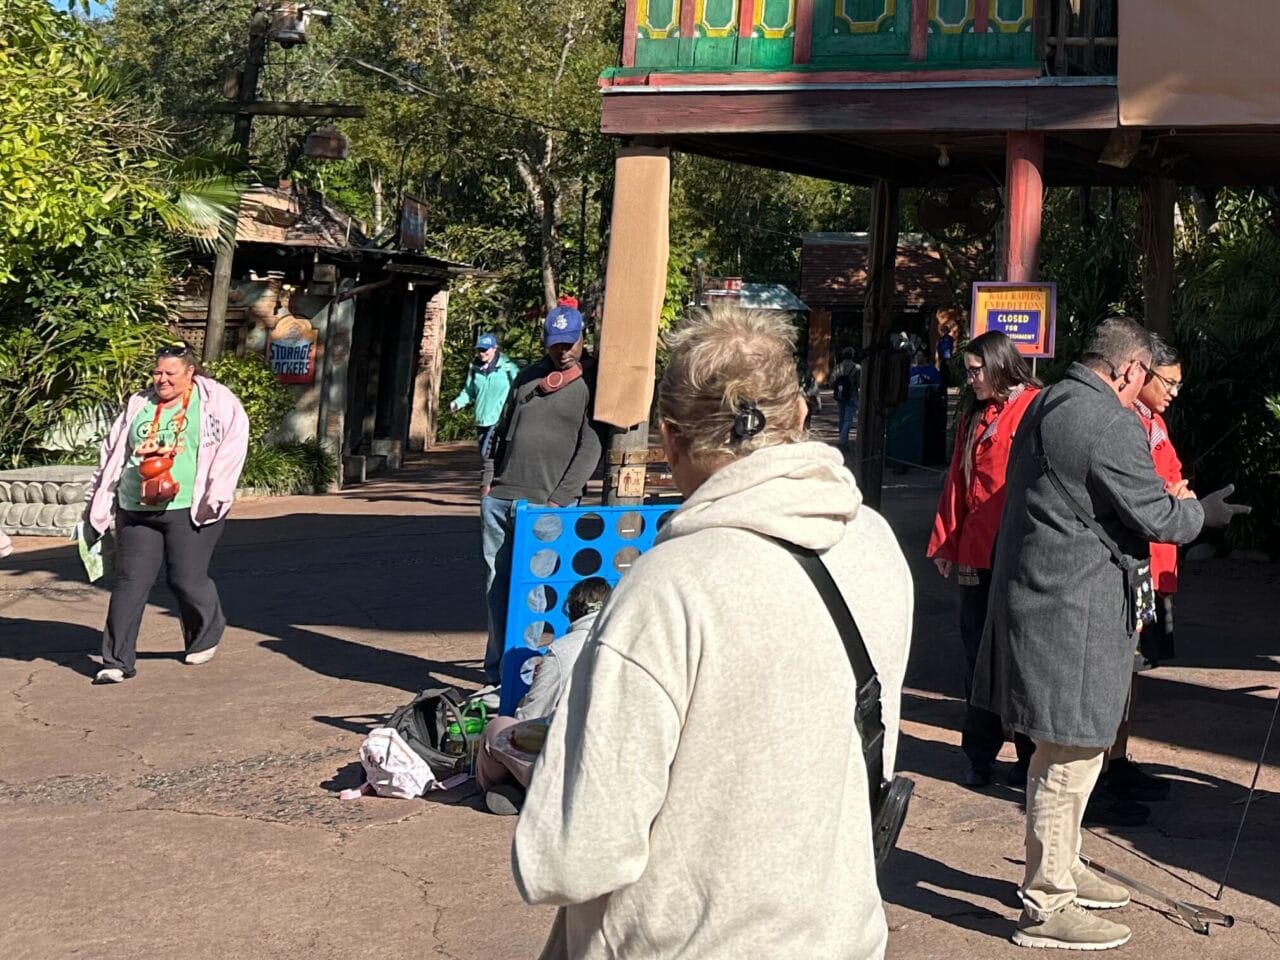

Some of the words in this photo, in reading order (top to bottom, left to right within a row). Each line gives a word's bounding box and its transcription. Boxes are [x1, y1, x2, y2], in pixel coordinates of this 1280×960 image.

[997, 314, 1029, 323] CLOSED
[1005, 324, 1018, 332] FOR
[271, 342, 313, 360] STORAGE
